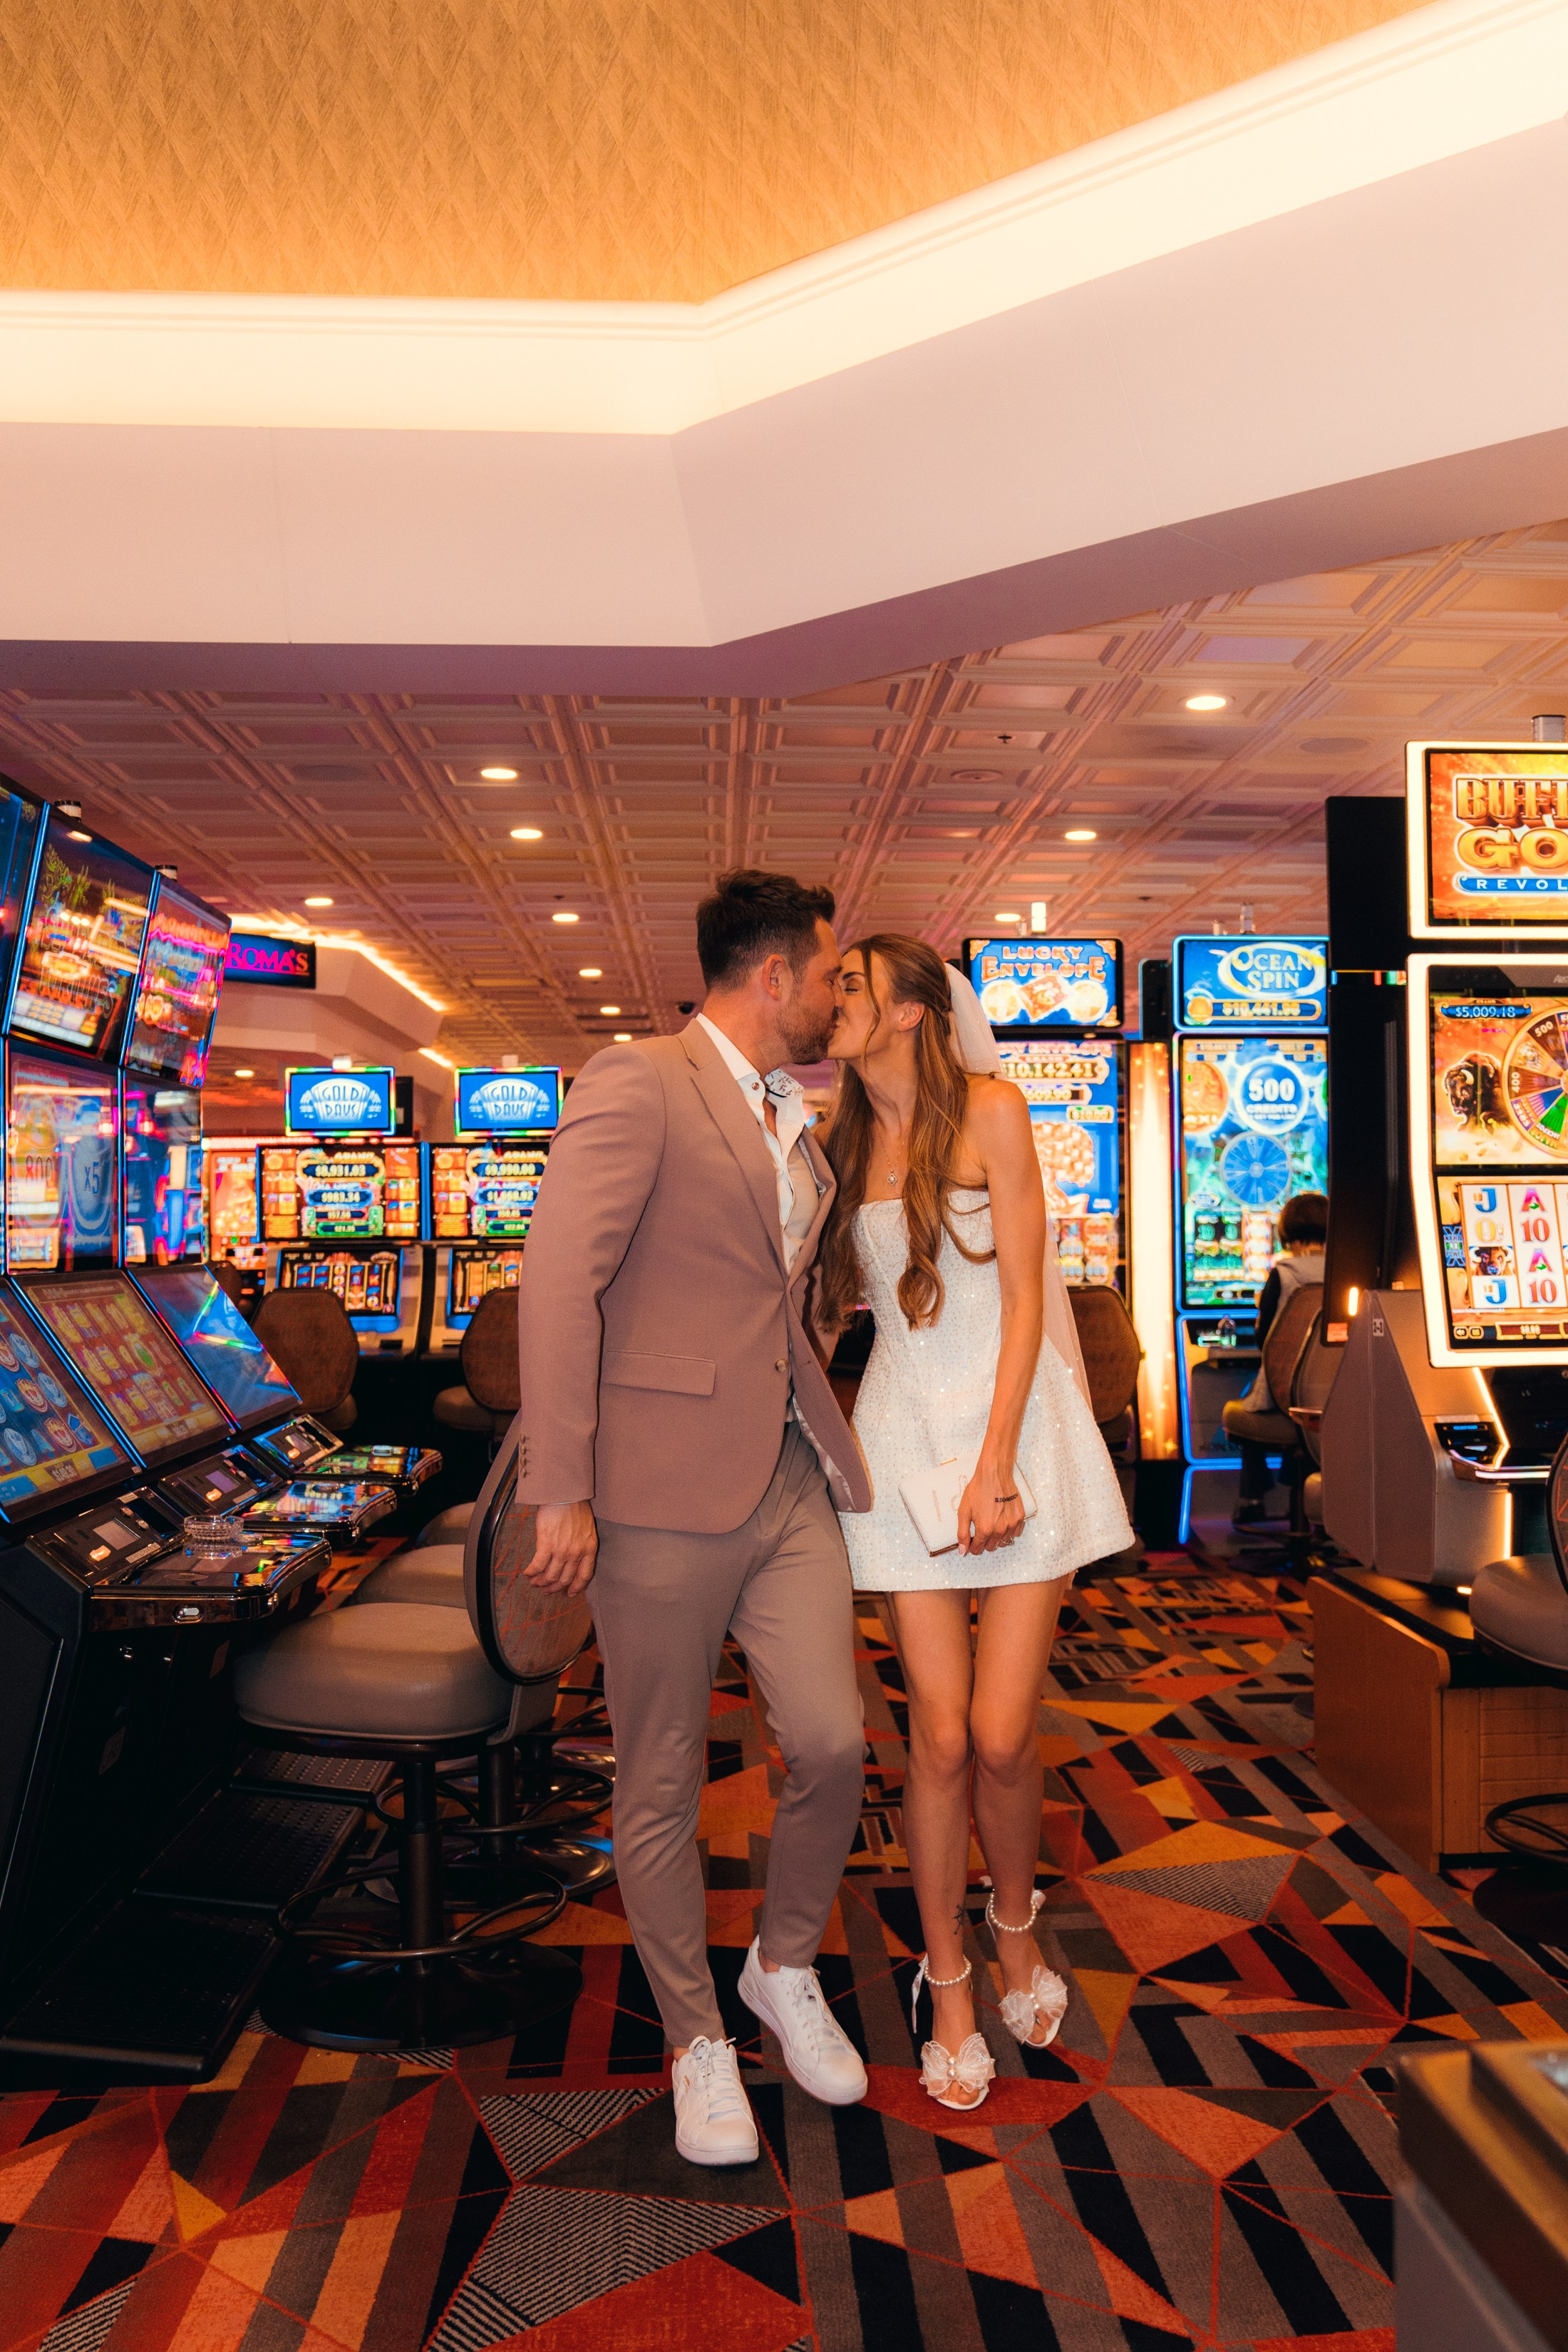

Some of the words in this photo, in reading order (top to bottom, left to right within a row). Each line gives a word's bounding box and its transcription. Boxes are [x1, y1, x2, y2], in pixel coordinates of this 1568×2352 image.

[1458, 827, 1568, 870] GO
[1476, 879, 1568, 890] REVOL
[1002, 946, 1083, 962] LUCKY
[1232, 947, 1313, 971] OCEAN
[981, 956, 1106, 983] ENVELOPE
[1247, 971, 1299, 992] SPIN
[1455, 1006, 1516, 1018] $5,009.18
[1534, 1021, 1554, 1038] 500
[1004, 1063, 1094, 1078] 10,142.41
[322, 1085, 359, 1101] GOLD
[490, 1085, 527, 1101] GOLD
[1248, 1078, 1296, 1102] 500
[1511, 1071, 1520, 1093] 400
[325, 1103, 356, 1116] DAYS
[494, 1103, 525, 1116] DAYS
[1475, 1187, 1497, 1213] J
[1521, 1187, 1546, 1213] A
[1522, 1218, 1550, 1242] 10
[1528, 1248, 1553, 1273] A
[1485, 1279, 1507, 1305] J
[1528, 1279, 1557, 1304] 10
